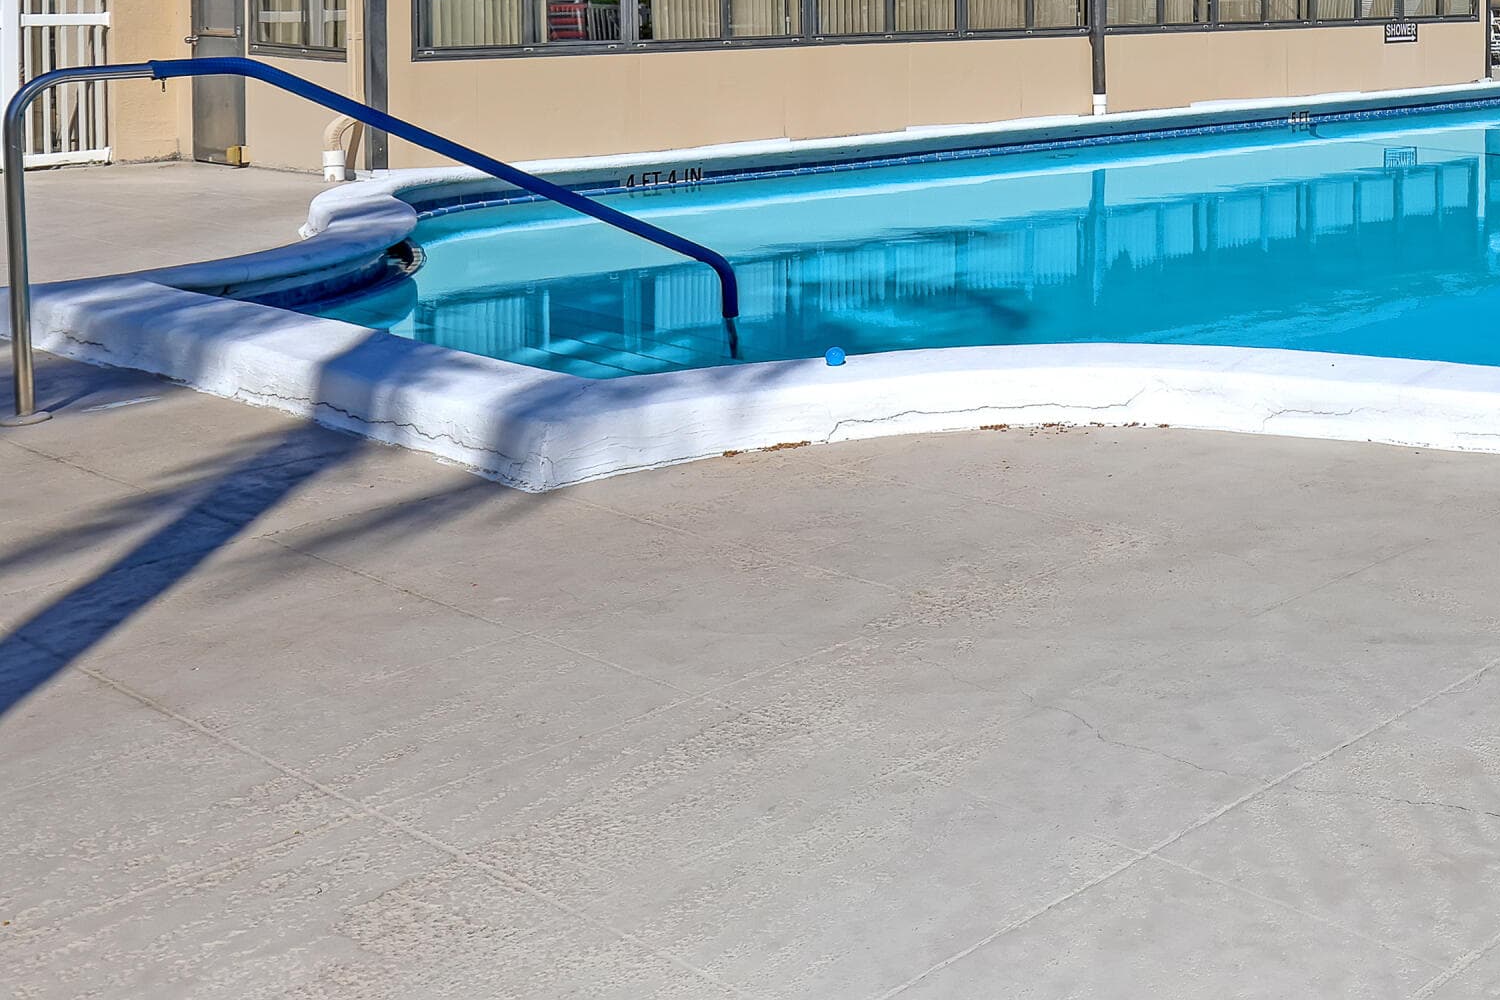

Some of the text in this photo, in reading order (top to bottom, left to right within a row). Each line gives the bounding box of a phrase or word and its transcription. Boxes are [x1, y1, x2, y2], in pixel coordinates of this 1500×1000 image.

[1386, 23, 1416, 36] SHOWER
[626, 167, 702, 187] 4 FT 4 IN
